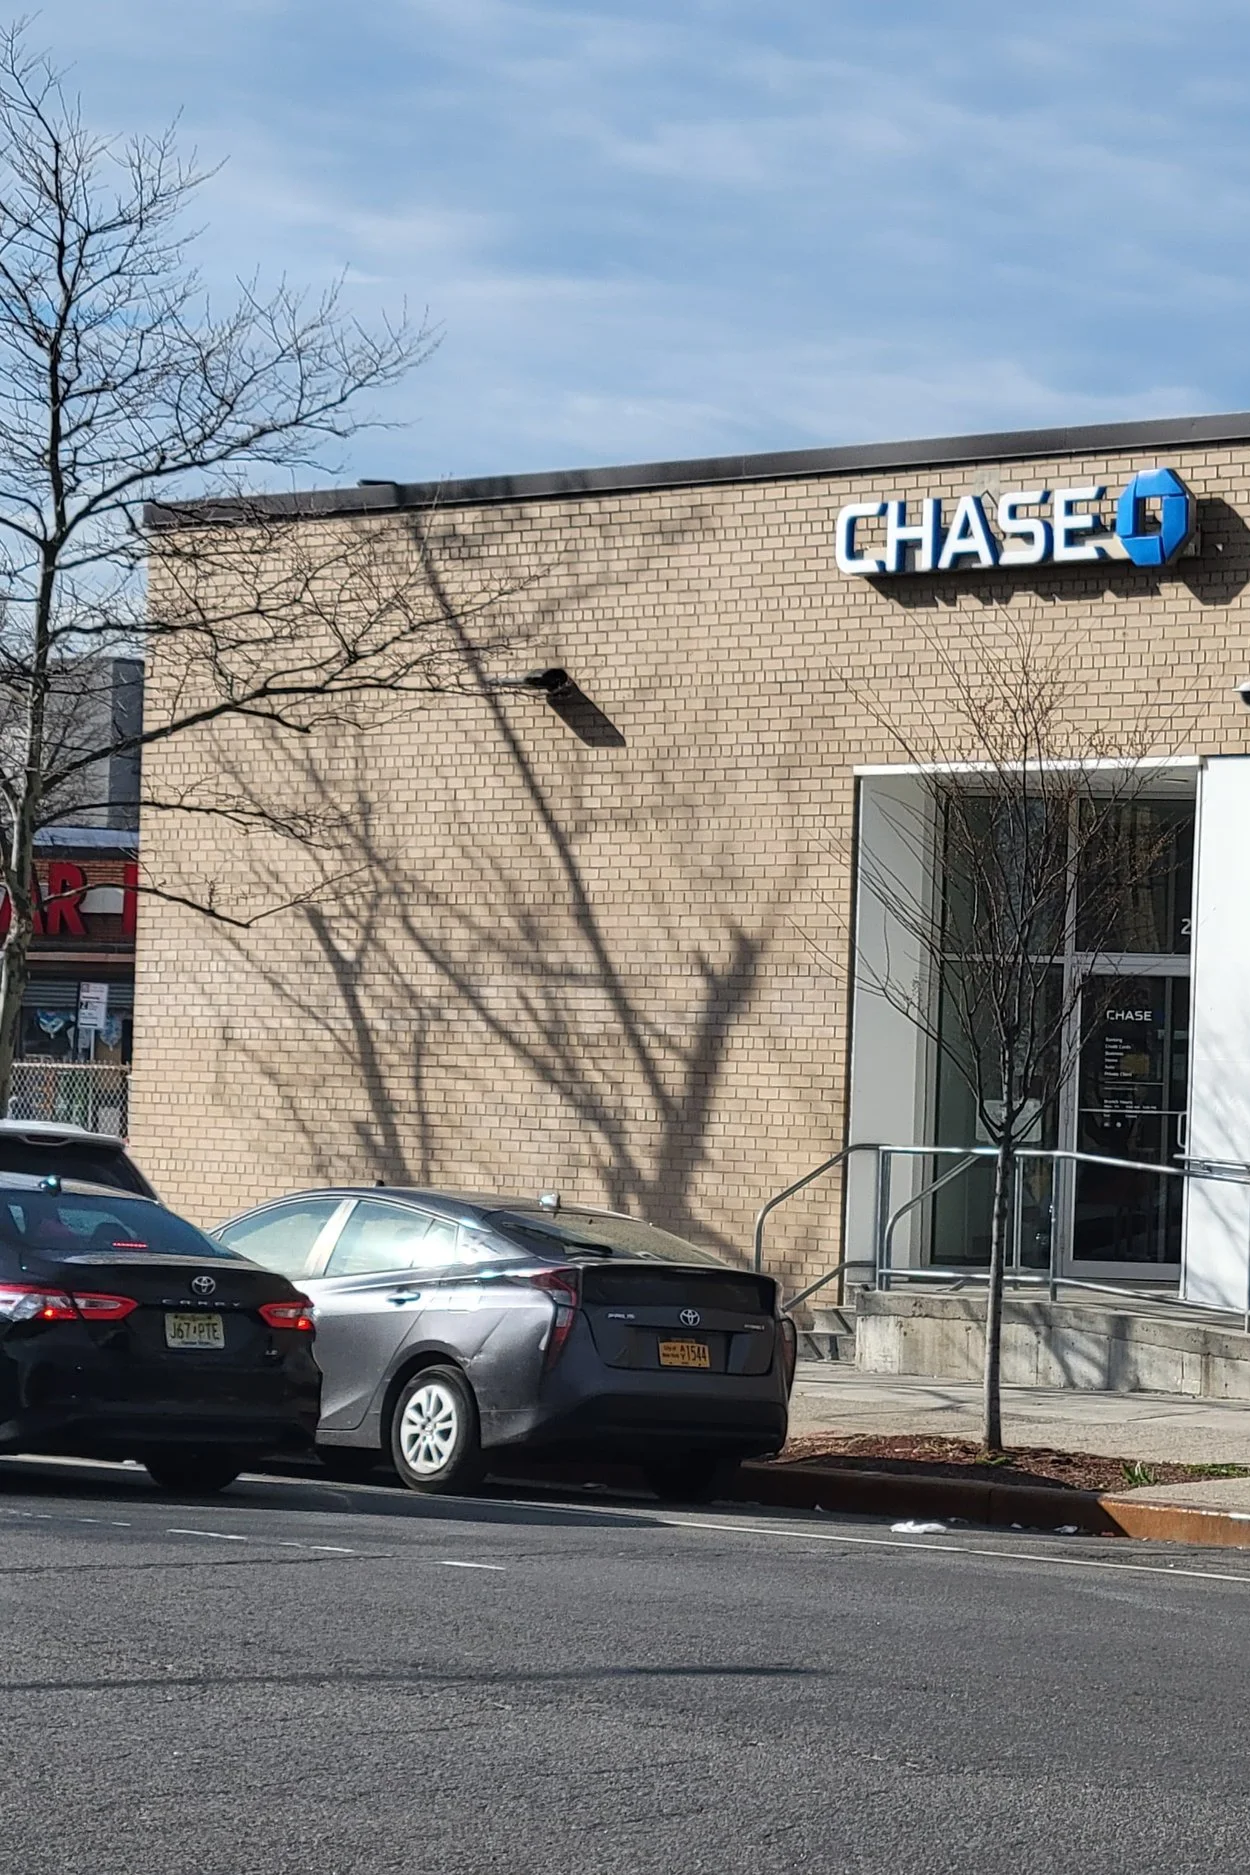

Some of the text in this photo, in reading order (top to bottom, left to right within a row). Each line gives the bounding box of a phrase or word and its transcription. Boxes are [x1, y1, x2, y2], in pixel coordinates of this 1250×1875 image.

[835, 486, 1106, 574] CHASE
[1106, 1010, 1153, 1021] CHASE
[686, 1344, 707, 1362] 1544
